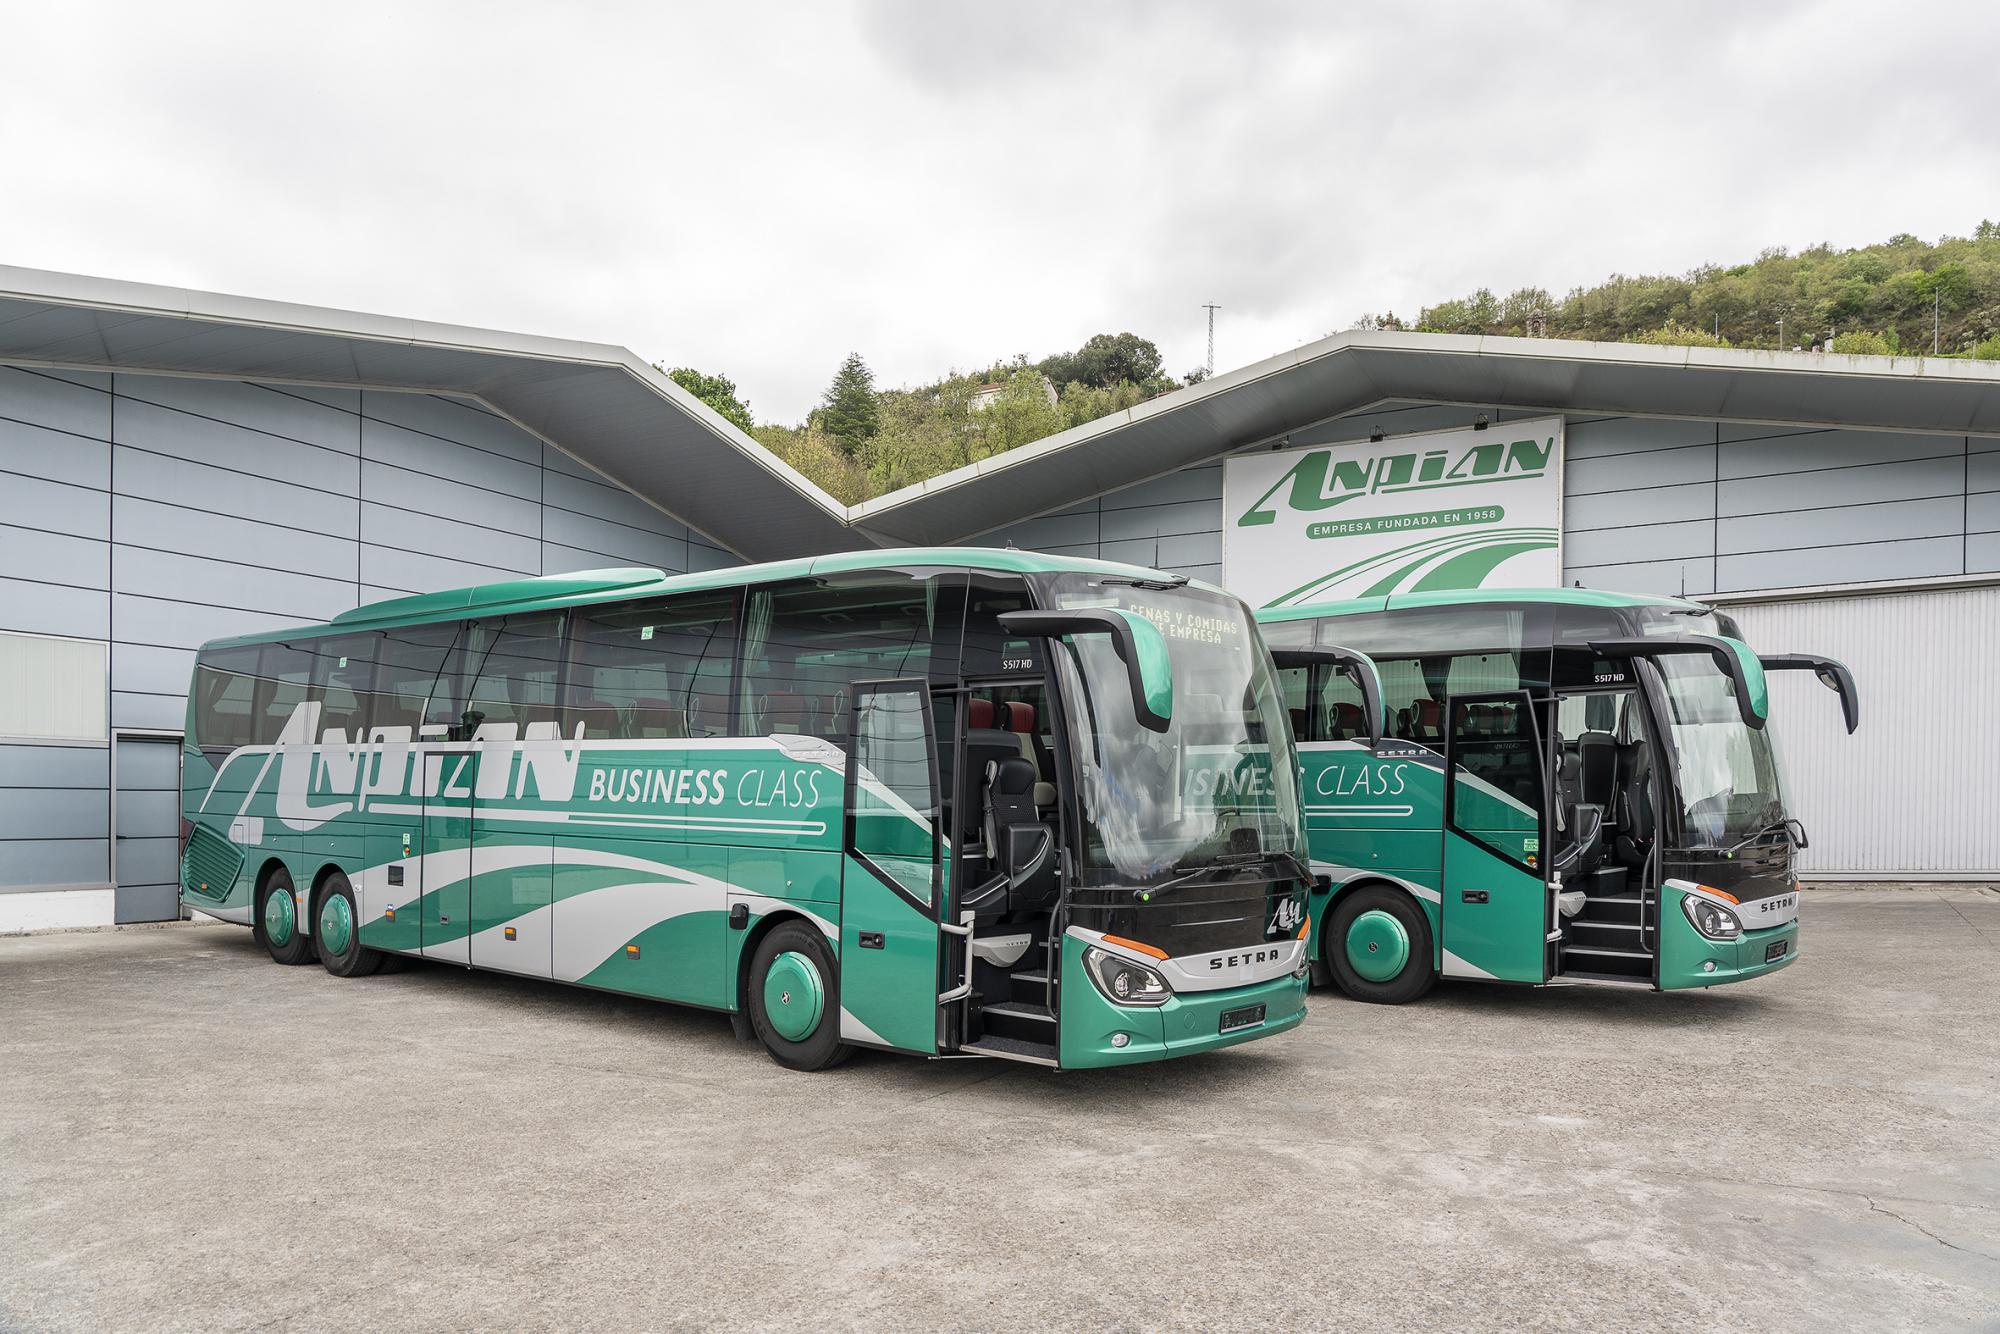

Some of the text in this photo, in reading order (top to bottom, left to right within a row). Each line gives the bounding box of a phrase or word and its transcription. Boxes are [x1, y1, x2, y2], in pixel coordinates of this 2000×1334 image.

[1313, 509, 1496, 536] EMPRESA FUNDADA EN 1958
[1130, 604, 1238, 635] CENAS Y COMIDAS
[1169, 624, 1222, 644] EMPRESA
[1020, 658, 1033, 669] HD
[1613, 673, 1625, 682] HD
[589, 768, 822, 808] BUSINESS CLASS
[1316, 764, 1408, 796] CLASS
[1761, 897, 1793, 913] SETRA
[1209, 949, 1279, 970] SETRA
